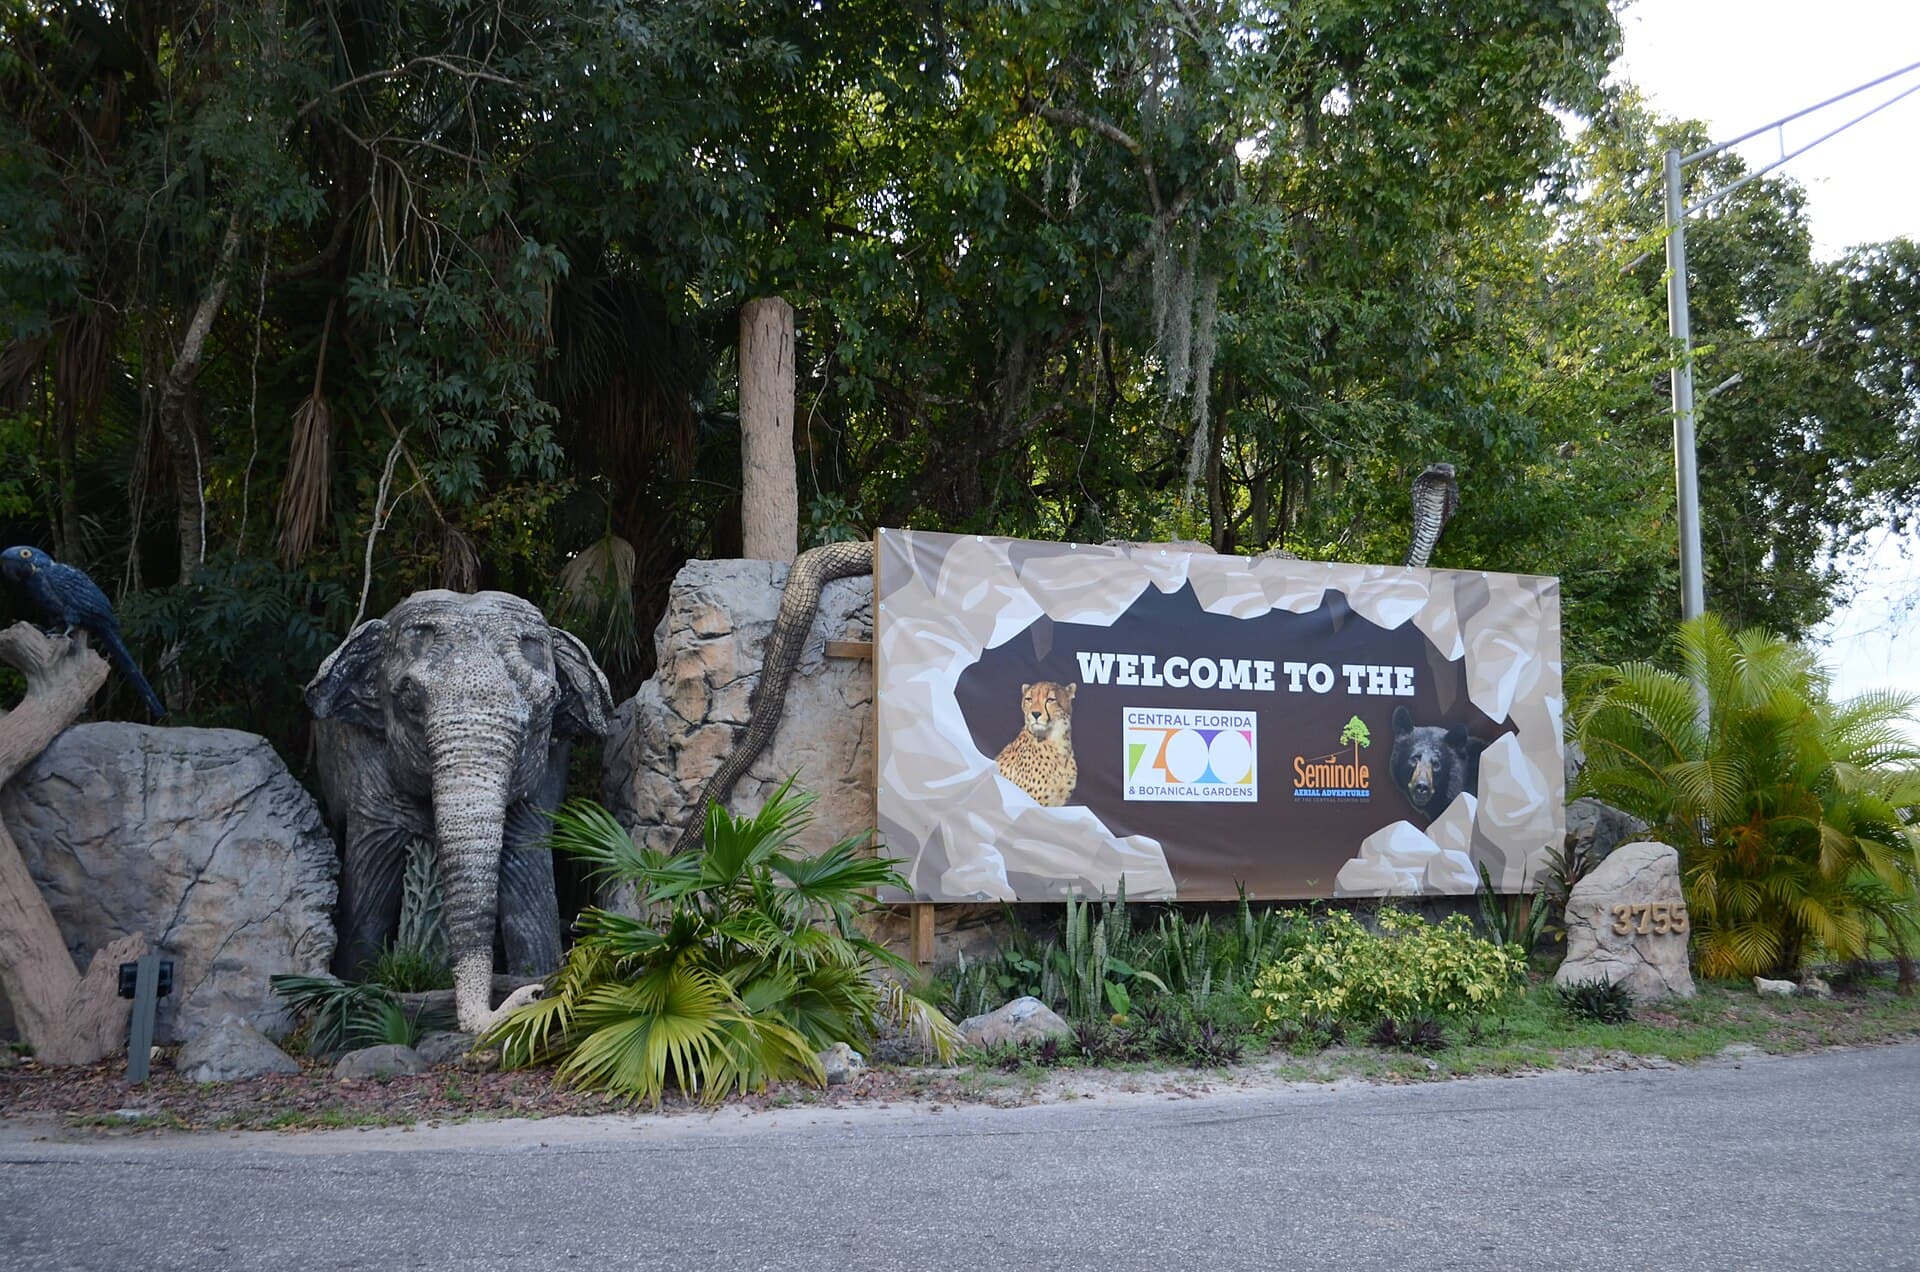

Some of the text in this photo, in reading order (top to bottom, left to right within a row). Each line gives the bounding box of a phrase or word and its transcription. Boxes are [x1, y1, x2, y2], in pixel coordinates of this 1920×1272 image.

[1076, 651, 1415, 696] WELCOME TO THE
[1128, 713, 1252, 728] CENTRAL FLORIDA
[1128, 728, 1252, 785] ZOO
[1293, 756, 1370, 789] Seminole
[1128, 786, 1253, 797] & BOTANICAL GARDENS
[1294, 789, 1370, 797] AERIAL ADVENTURES
[1611, 902, 1687, 936] 3755
